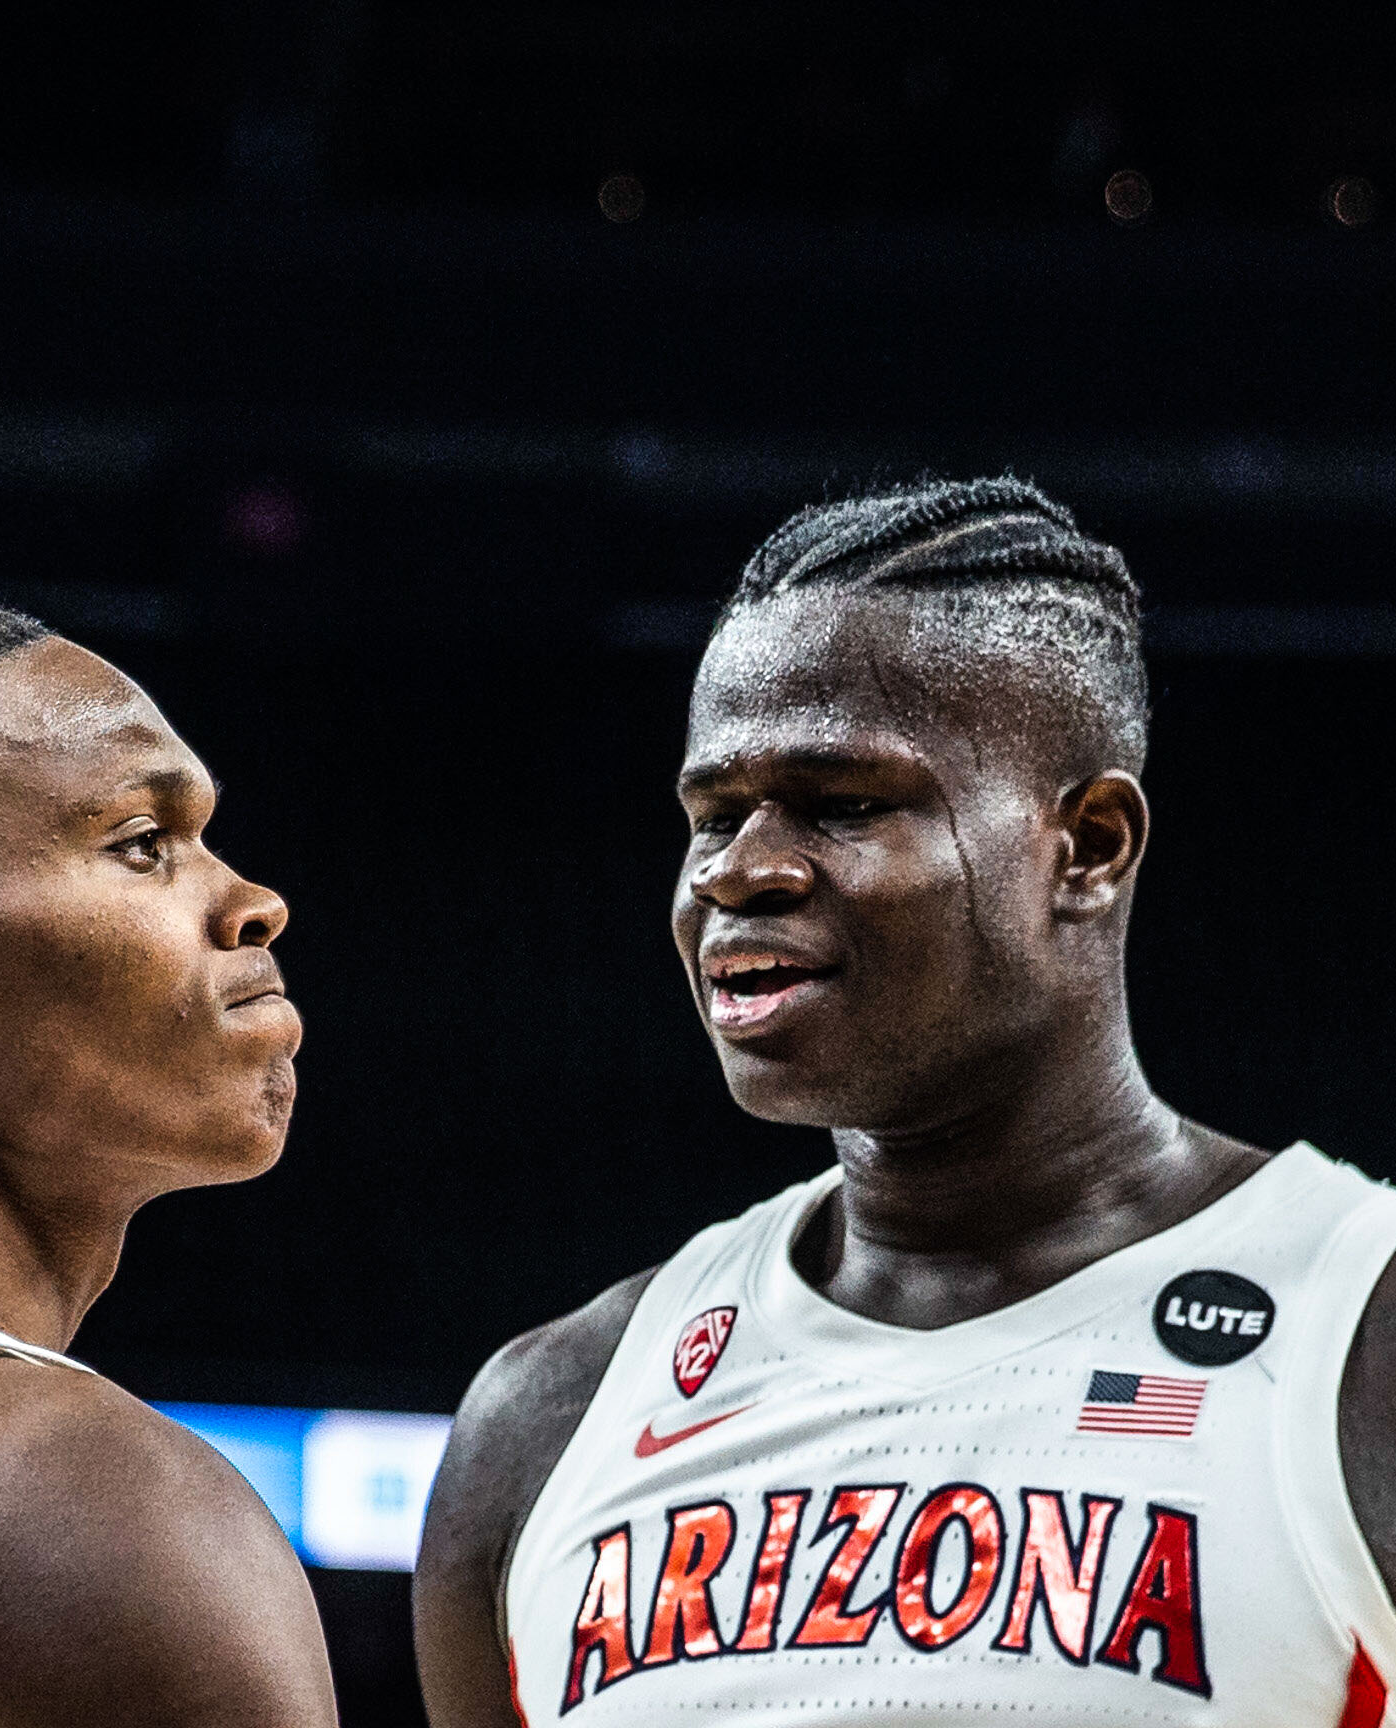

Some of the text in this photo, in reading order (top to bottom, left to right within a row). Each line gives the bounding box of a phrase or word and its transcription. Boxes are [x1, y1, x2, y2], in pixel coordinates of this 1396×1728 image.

[1164, 1296, 1268, 1335] LUTE
[678, 1341, 711, 1381] 12
[559, 1482, 1213, 1718] ARIZONA
